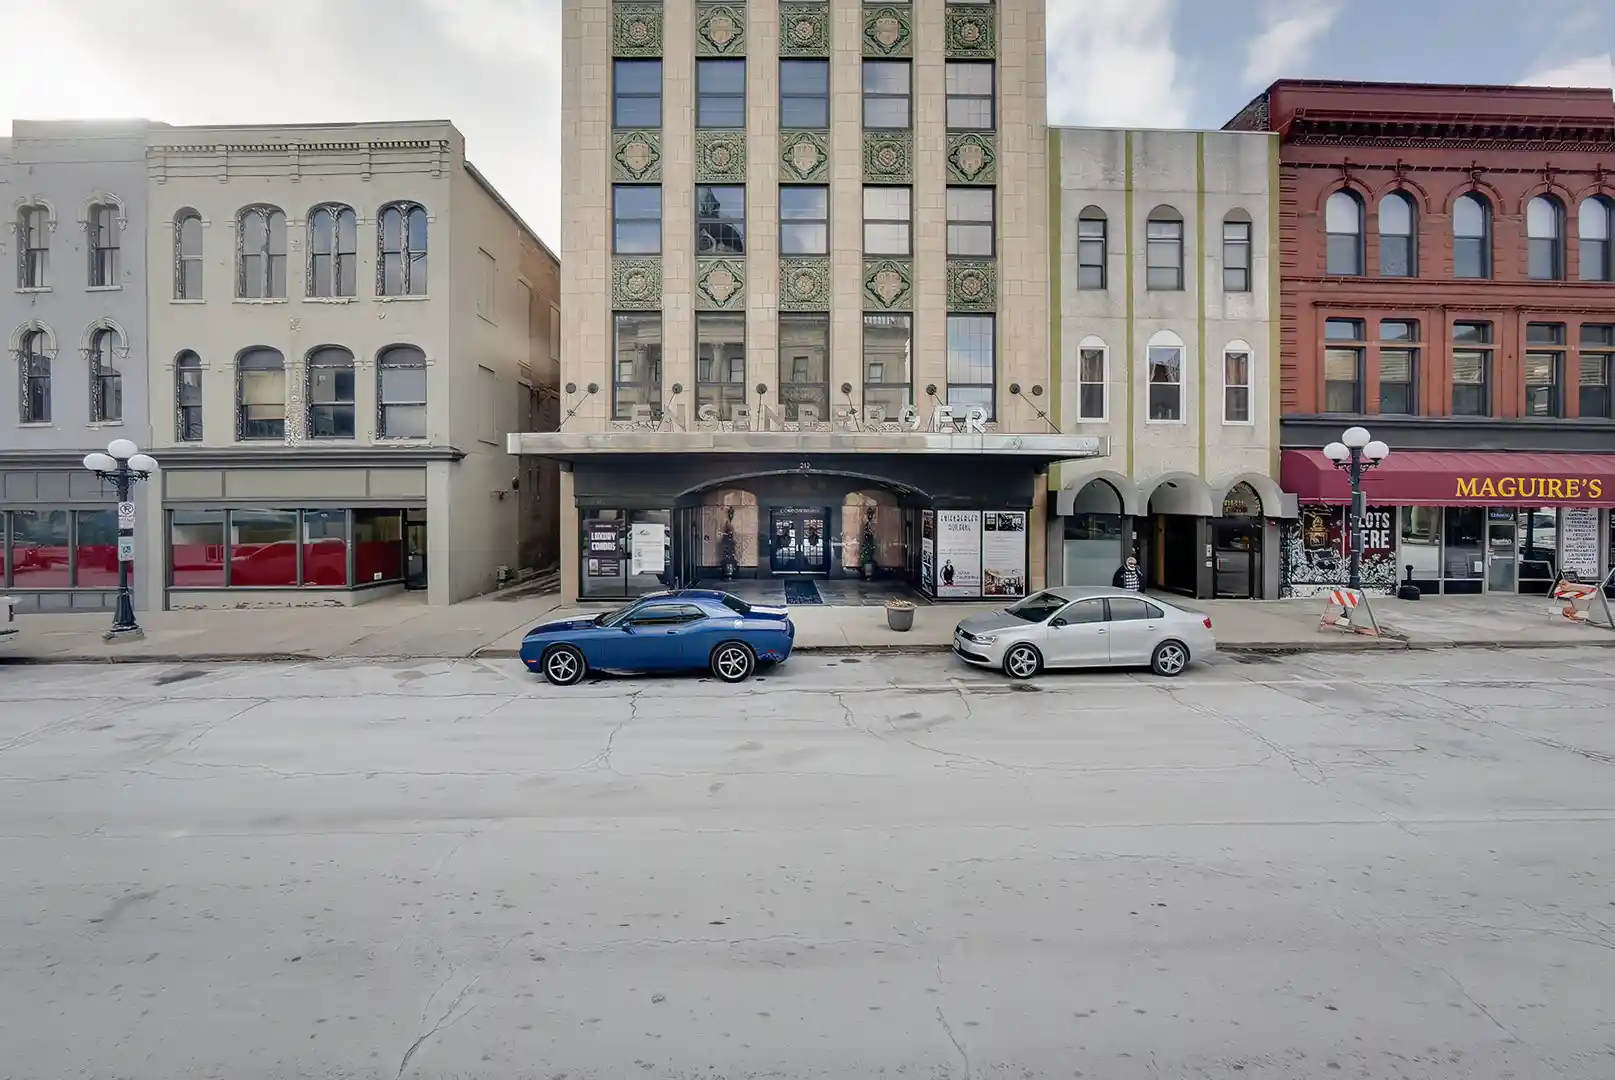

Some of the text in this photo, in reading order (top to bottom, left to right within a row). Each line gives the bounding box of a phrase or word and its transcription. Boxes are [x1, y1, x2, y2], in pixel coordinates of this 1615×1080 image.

[1455, 477, 1602, 498] MAGUIRE'S
[1349, 511, 1390, 529] LOTS
[1349, 529, 1390, 549] ERE
